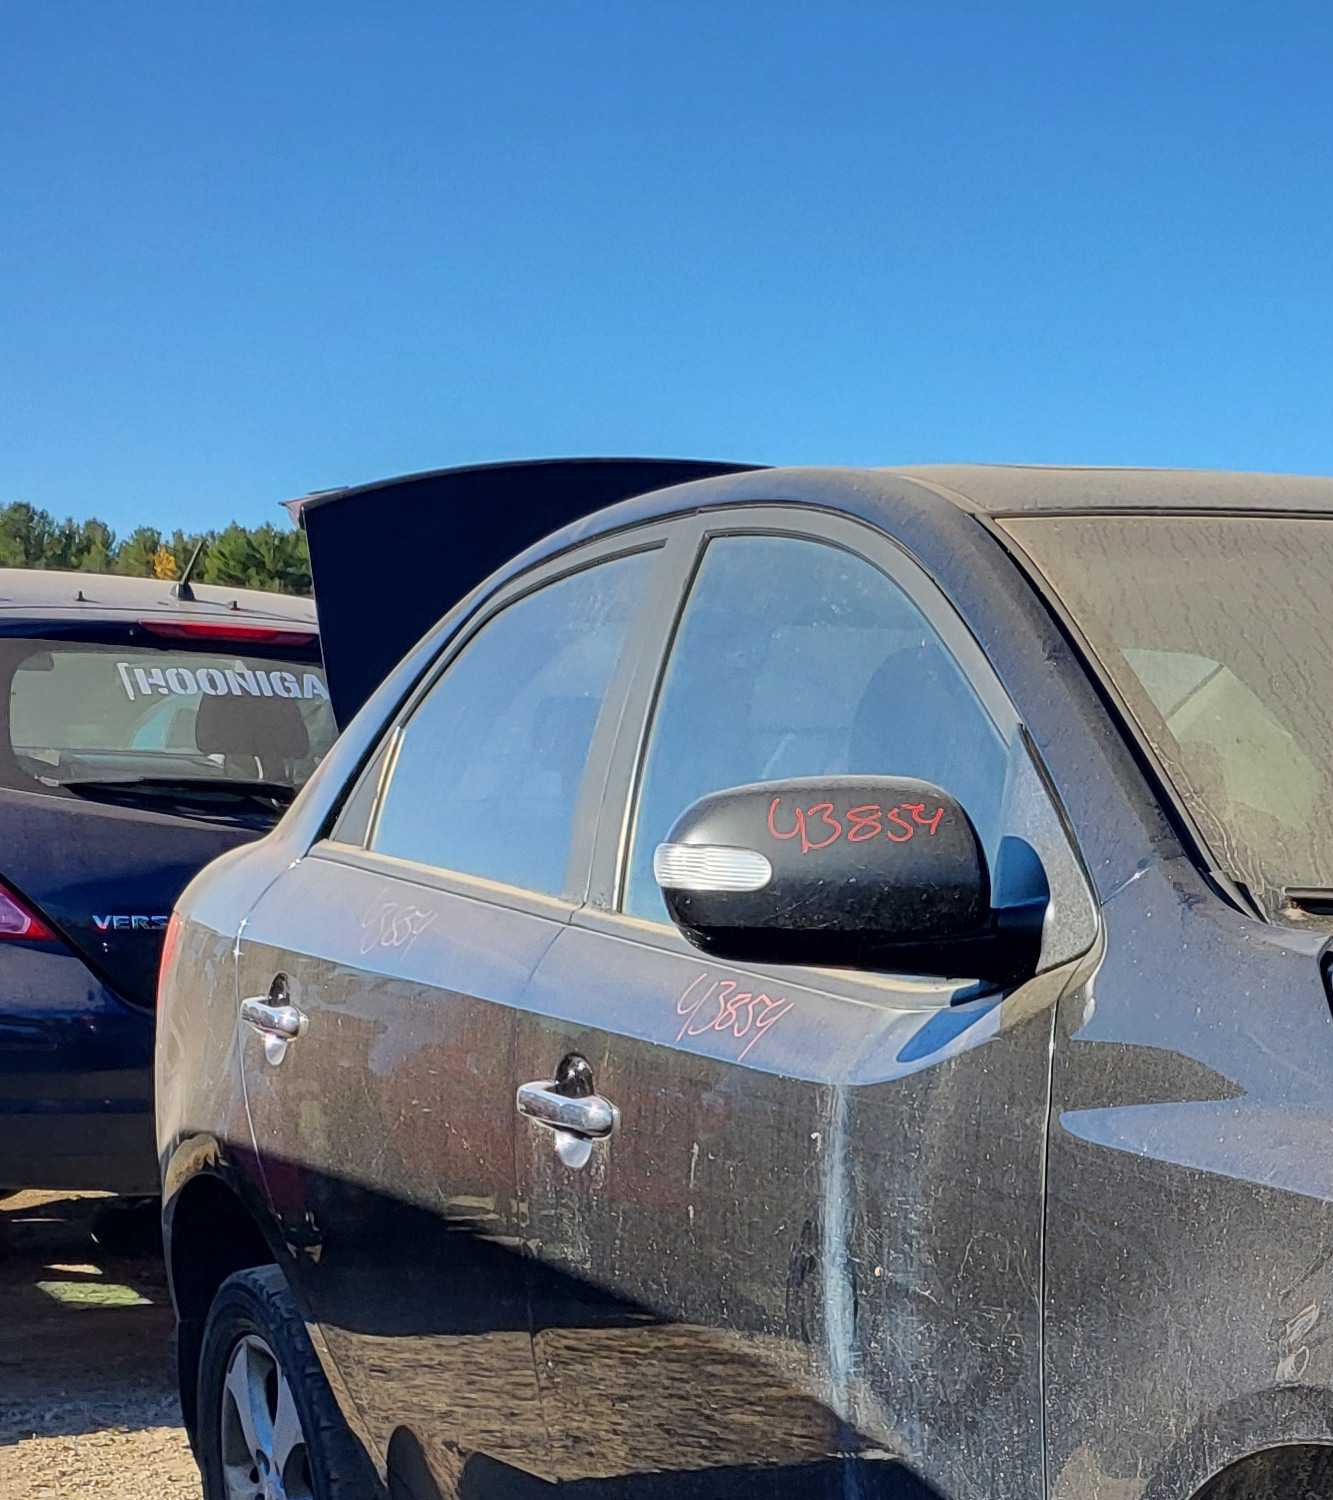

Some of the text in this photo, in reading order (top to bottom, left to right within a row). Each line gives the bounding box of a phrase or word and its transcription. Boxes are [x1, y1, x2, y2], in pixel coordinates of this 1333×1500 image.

[133, 667, 331, 700] HOONIGA
[767, 798, 945, 854] 43854
[92, 914, 169, 930] VERS
[675, 972, 795, 1063] 43854
